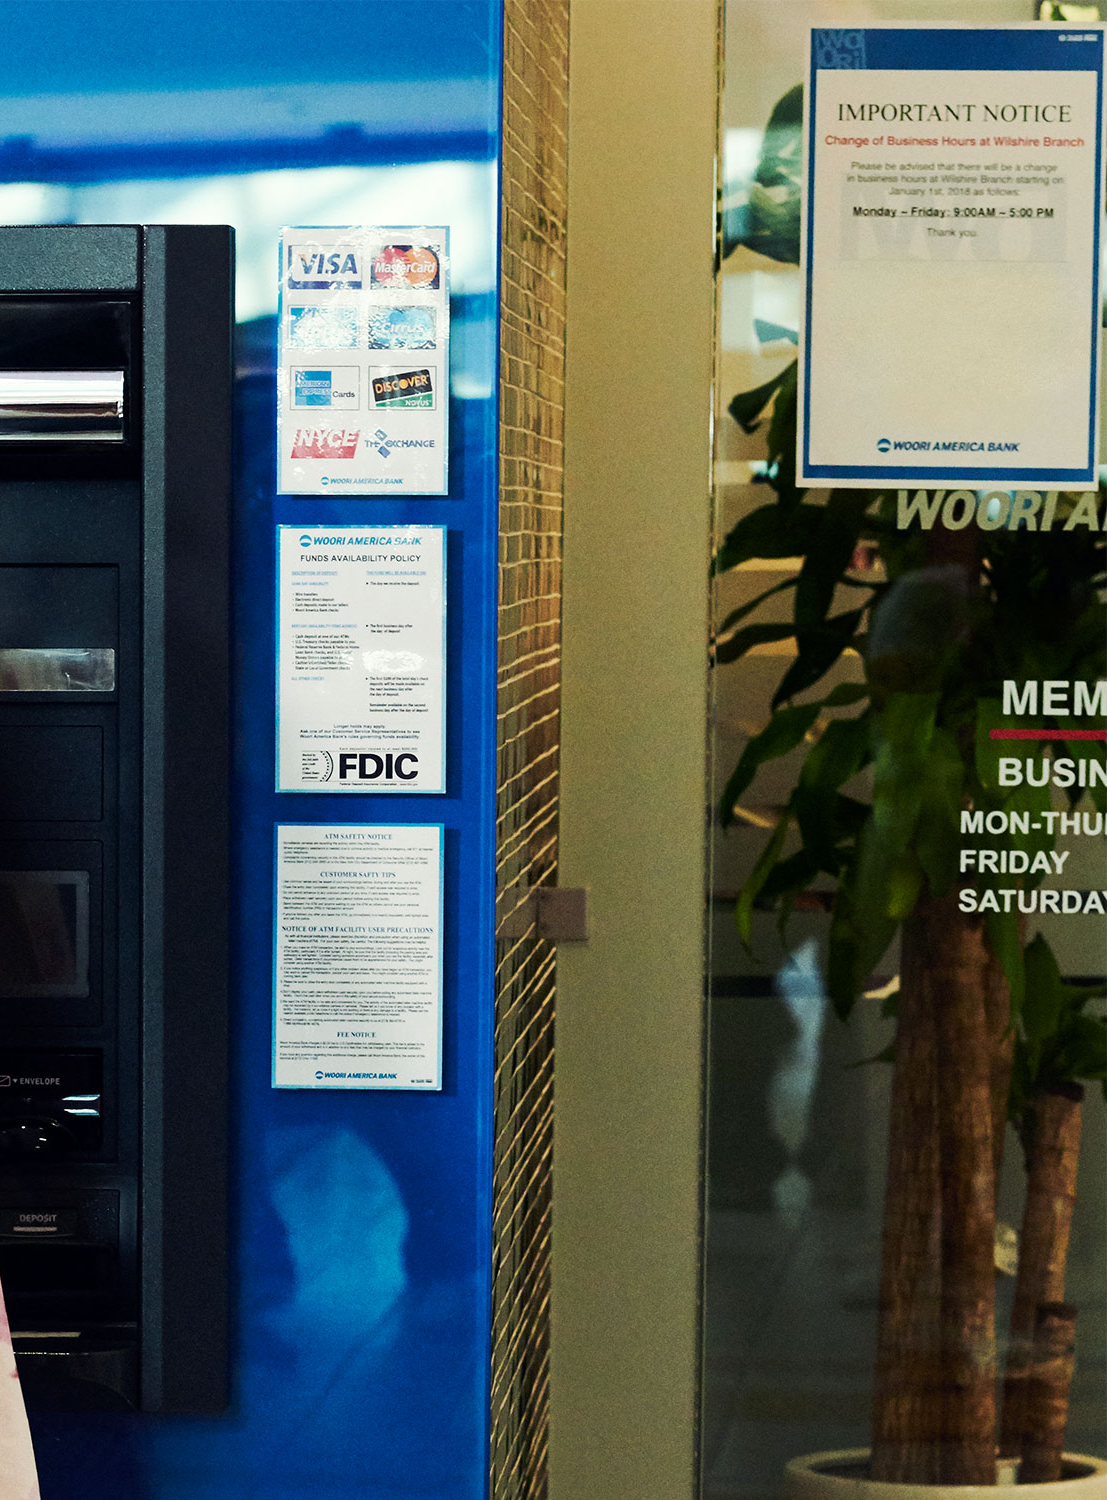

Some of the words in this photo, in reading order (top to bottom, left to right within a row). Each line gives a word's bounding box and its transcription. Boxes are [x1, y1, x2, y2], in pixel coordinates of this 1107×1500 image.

[839, 104, 976, 122] IMPORTANT
[984, 104, 1072, 122] NOTICE
[825, 135, 869, 148] Change
[872, 136, 883, 147] of
[888, 136, 938, 147] Business
[942, 136, 976, 147] Hours
[979, 137, 990, 147] at
[994, 137, 1039, 147] Wilshire
[1044, 138, 1085, 147] Branch
[851, 162, 882, 170] Please
[885, 162, 896, 170] be
[899, 163, 935, 171] advised
[938, 163, 955, 171] that
[958, 163, 980, 171] there
[984, 163, 998, 171] will
[1001, 163, 1012, 171] be
[1023, 163, 1057, 173] change
[847, 174, 855, 182] in
[857, 175, 898, 183] business
[901, 175, 926, 183] hours
[929, 175, 938, 183] at
[941, 175, 977, 183] Wilshire
[980, 175, 1013, 183] Branch
[1016, 176, 1049, 186] starting
[853, 207, 896, 218] Monday
[954, 207, 995, 217] 9:00AM
[1009, 207, 1033, 217] 5:00
[1037, 208, 1054, 217] PM
[927, 228, 956, 237] Thank
[298, 254, 358, 274] VISA
[375, 262, 435, 273] MasterCard
[375, 375, 428, 394] DISCOVER
[297, 430, 359, 446] NYCE
[893, 441, 931, 450] WOORI
[933, 442, 985, 451] AMERICA
[987, 442, 1021, 451] BANK
[896, 489, 1059, 531] WOORI
[1063, 491, 1107, 531] A
[314, 537, 346, 545] WOORI
[347, 537, 392, 545] AMERICA
[1003, 680, 1107, 716] MEM
[339, 754, 419, 780] FDIC
[999, 758, 1107, 787] BUSIN
[960, 811, 1107, 836] MON-THU
[960, 850, 1070, 874] FRIDAY
[958, 889, 1107, 914] SATURDA
[19, 1077, 60, 1085] ENVELOPE
[19, 1214, 57, 1222] DEPOSIT
